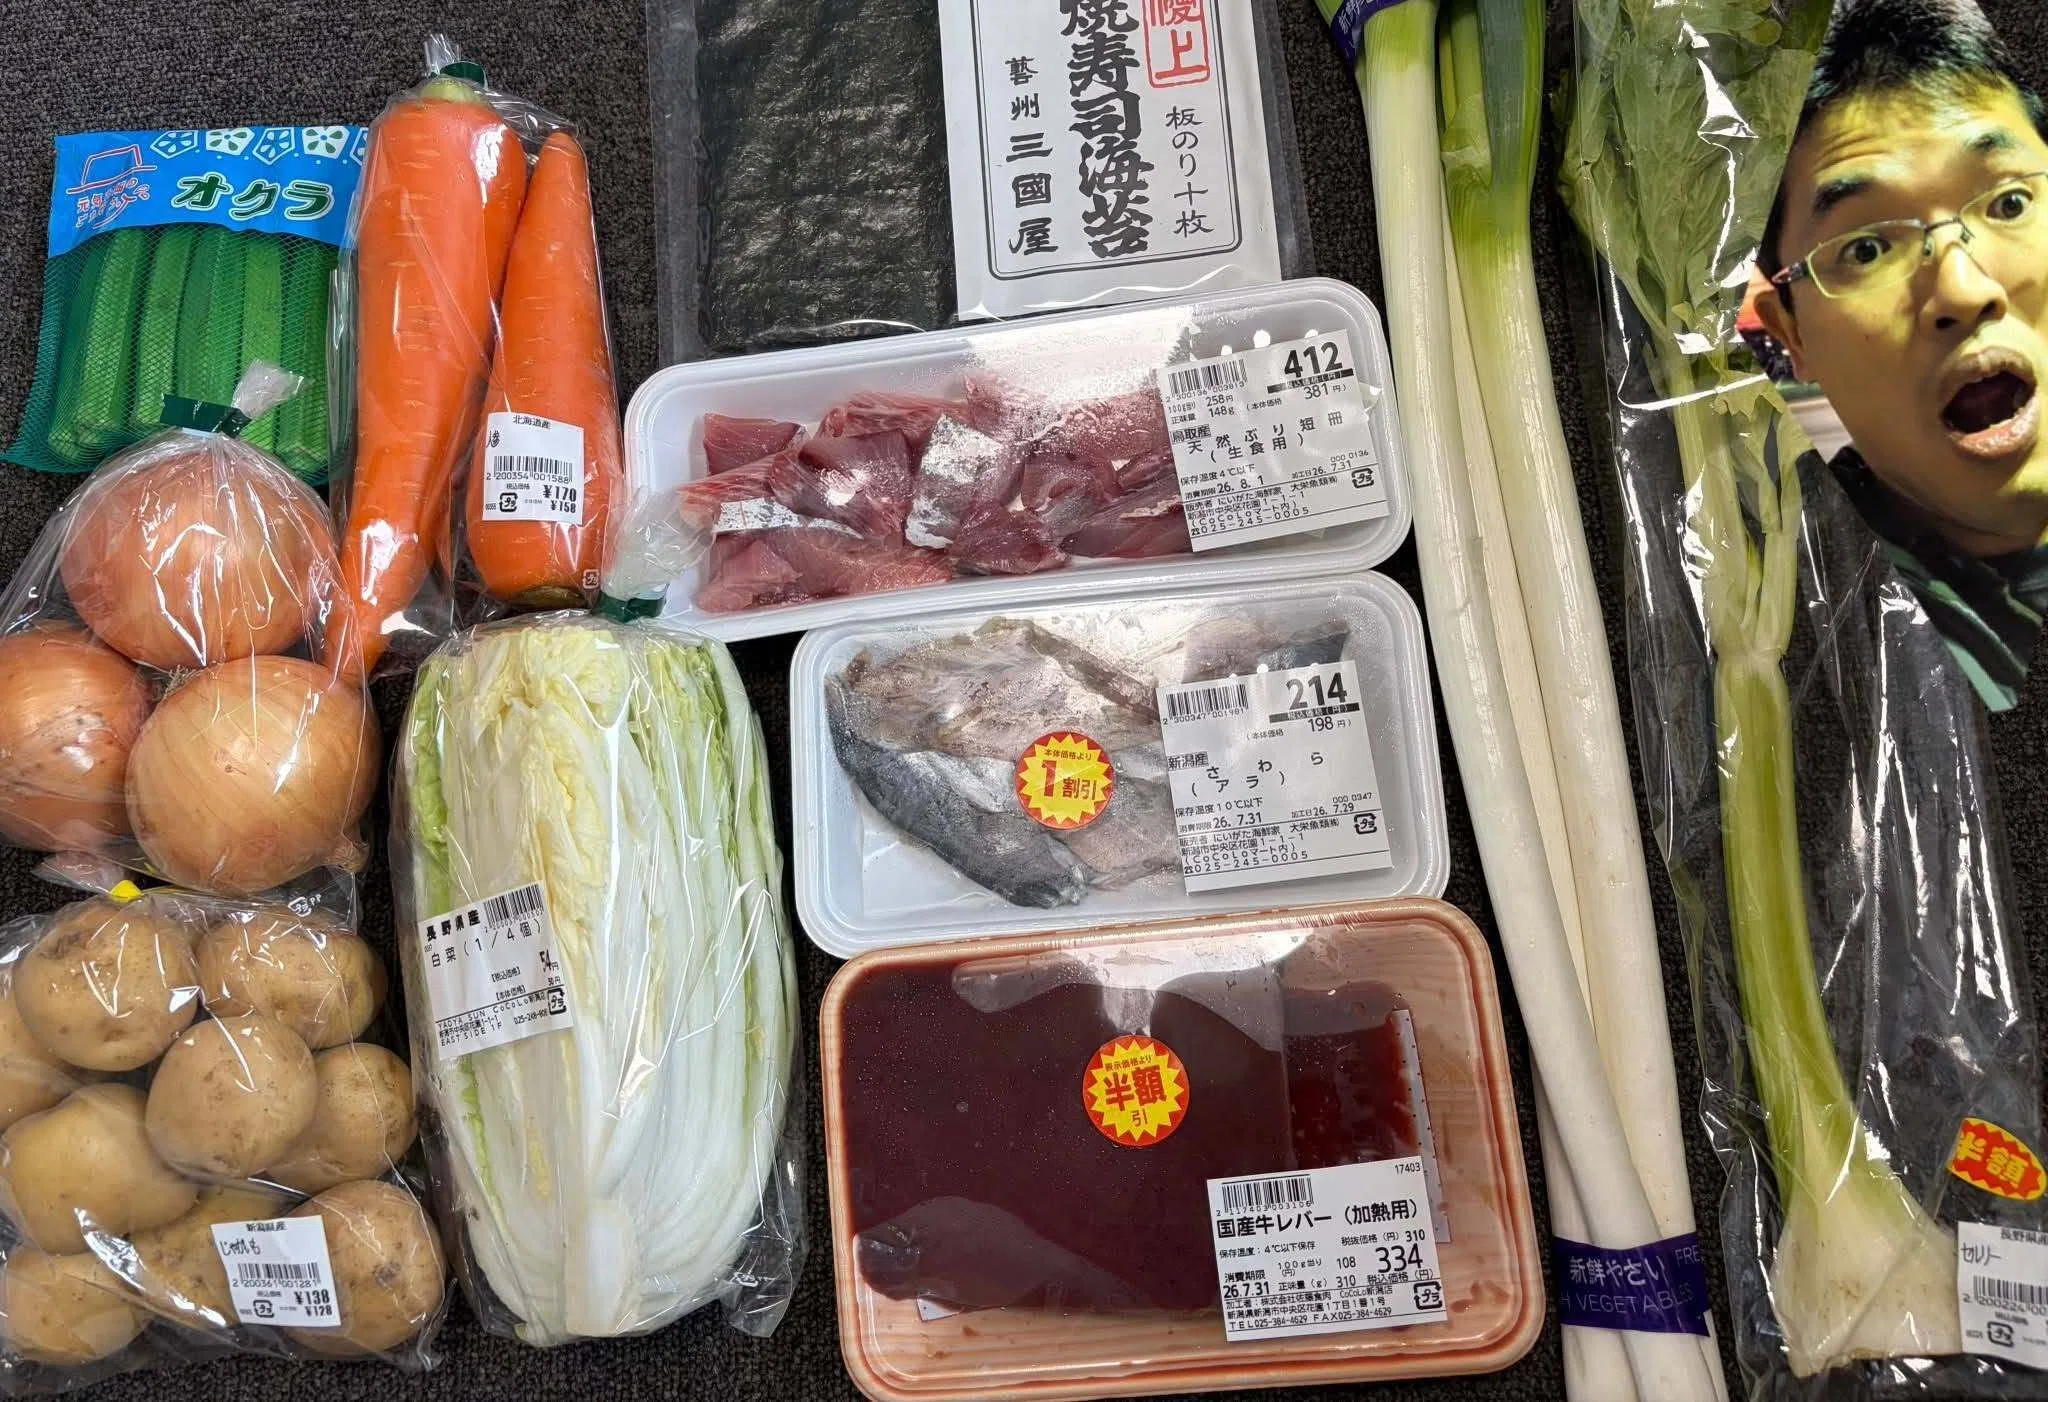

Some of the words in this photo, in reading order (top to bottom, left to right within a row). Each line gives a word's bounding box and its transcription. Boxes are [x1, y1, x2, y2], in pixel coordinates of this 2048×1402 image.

[1165, 105, 1216, 239] 板のり十枚
[171, 172, 335, 221] オクラ
[1284, 341, 1344, 378] 412
[1303, 382, 1329, 400] 381
[1205, 394, 1234, 407] 258円
[1208, 406, 1235, 418] 148g
[512, 415, 552, 429] 北海道産
[1170, 424, 1212, 445] 鳥取産
[542, 484, 577, 502] ¥170
[550, 499, 577, 513] ¥158
[1286, 672, 1348, 710] 214
[1307, 716, 1334, 732] 198
[1044, 749, 1092, 761] 本体価格より
[1167, 751, 1210, 771] 新潟産
[1041, 759, 1057, 797] 1
[1062, 777, 1097, 800] 割引
[426, 909, 481, 942] 長野県産
[1103, 1065, 1167, 1112] 半額
[1132, 1108, 1148, 1127] 引
[1394, 1162, 1421, 1174] 17403
[1405, 1229, 1426, 1242] 310
[1336, 1256, 1357, 1269] 108
[1375, 1243, 1424, 1273] 334
[1675, 1245, 1704, 1266] FRE
[1224, 1269, 1267, 1283] 消費期限
[1568, 1255, 1665, 1288] 新鮮やさい
[1223, 1281, 1270, 1299] 26.7.31
[1336, 1275, 1357, 1288] 310
[294, 1288, 330, 1305] ¥138
[1421, 1288, 1440, 1304] プラ
[304, 1305, 333, 1316] ¥128
